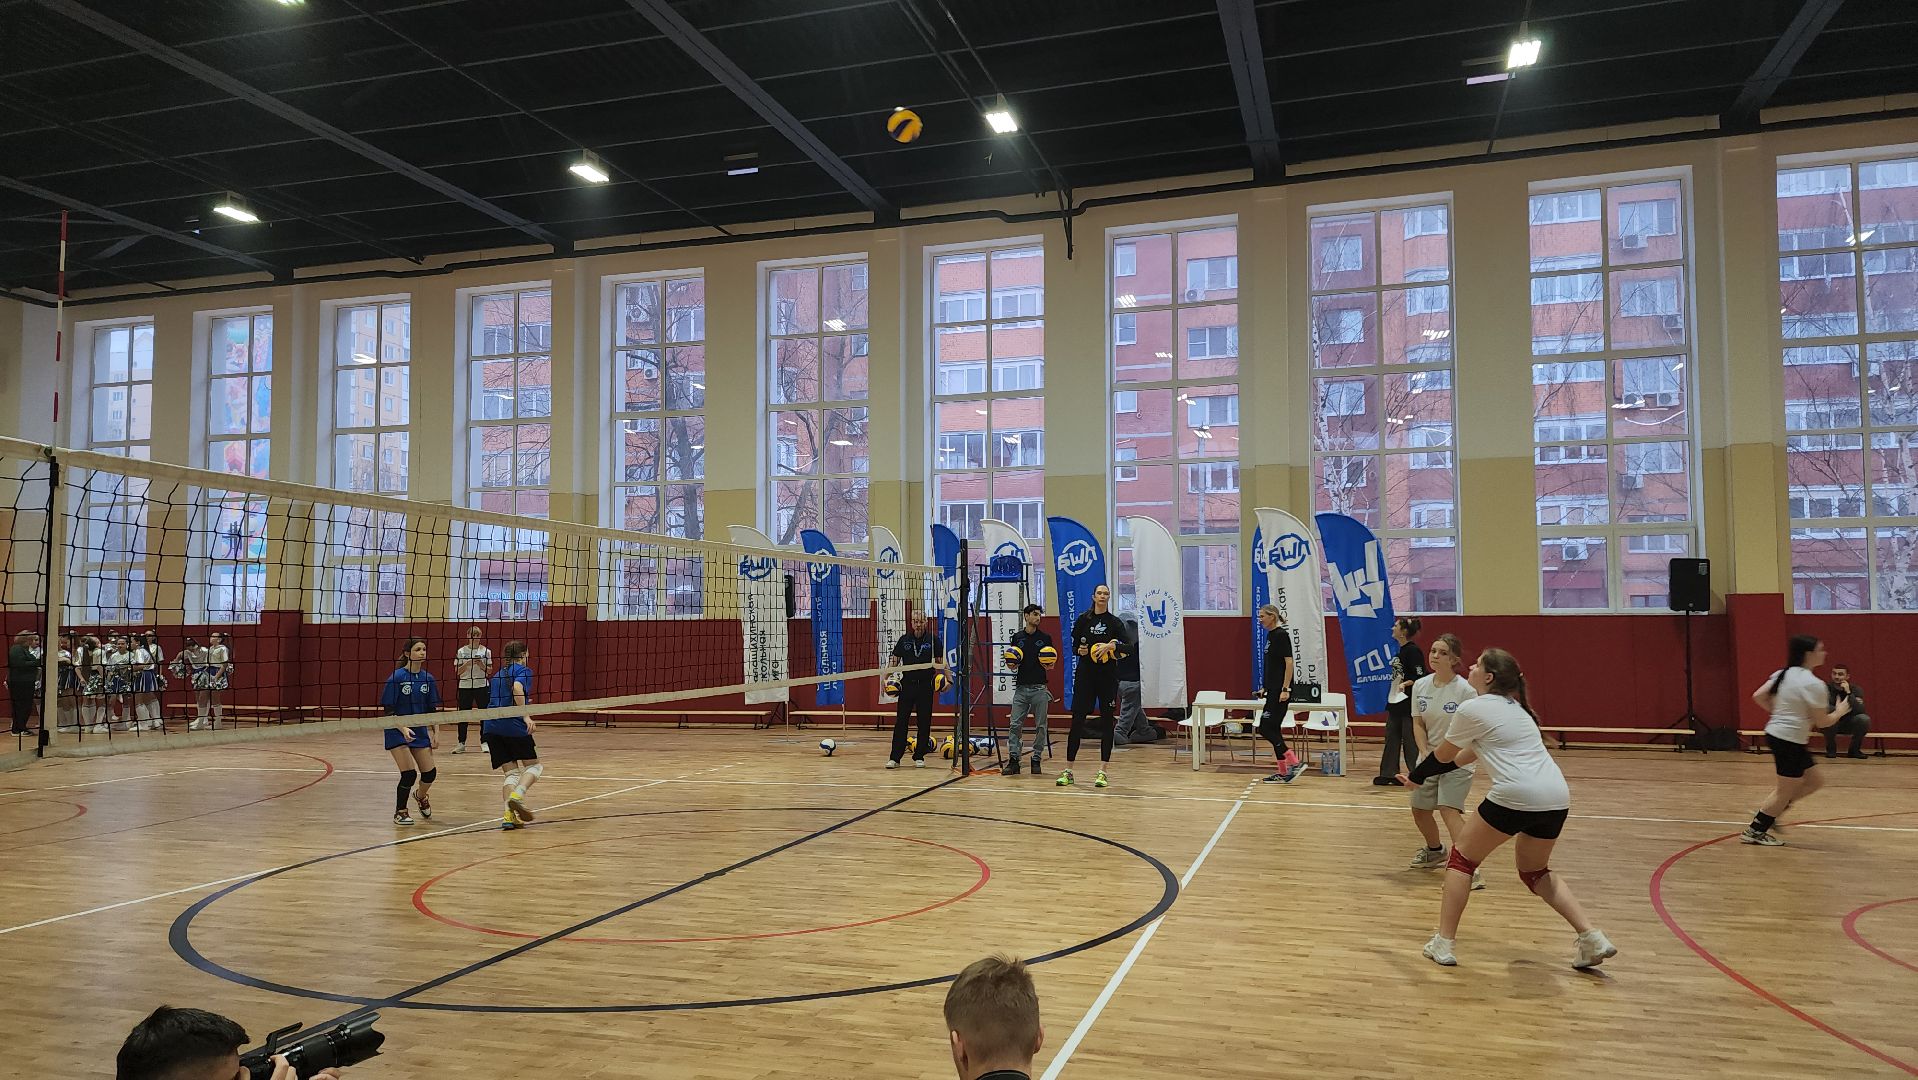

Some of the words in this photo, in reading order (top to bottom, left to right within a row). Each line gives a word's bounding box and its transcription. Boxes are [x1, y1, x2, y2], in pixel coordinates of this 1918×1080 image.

[1057, 545, 1097, 571] БШЛ
[1269, 540, 1311, 565] БШЛ
[1353, 643, 1394, 677] ГО!
[1311, 687, 1319, 698] 0
